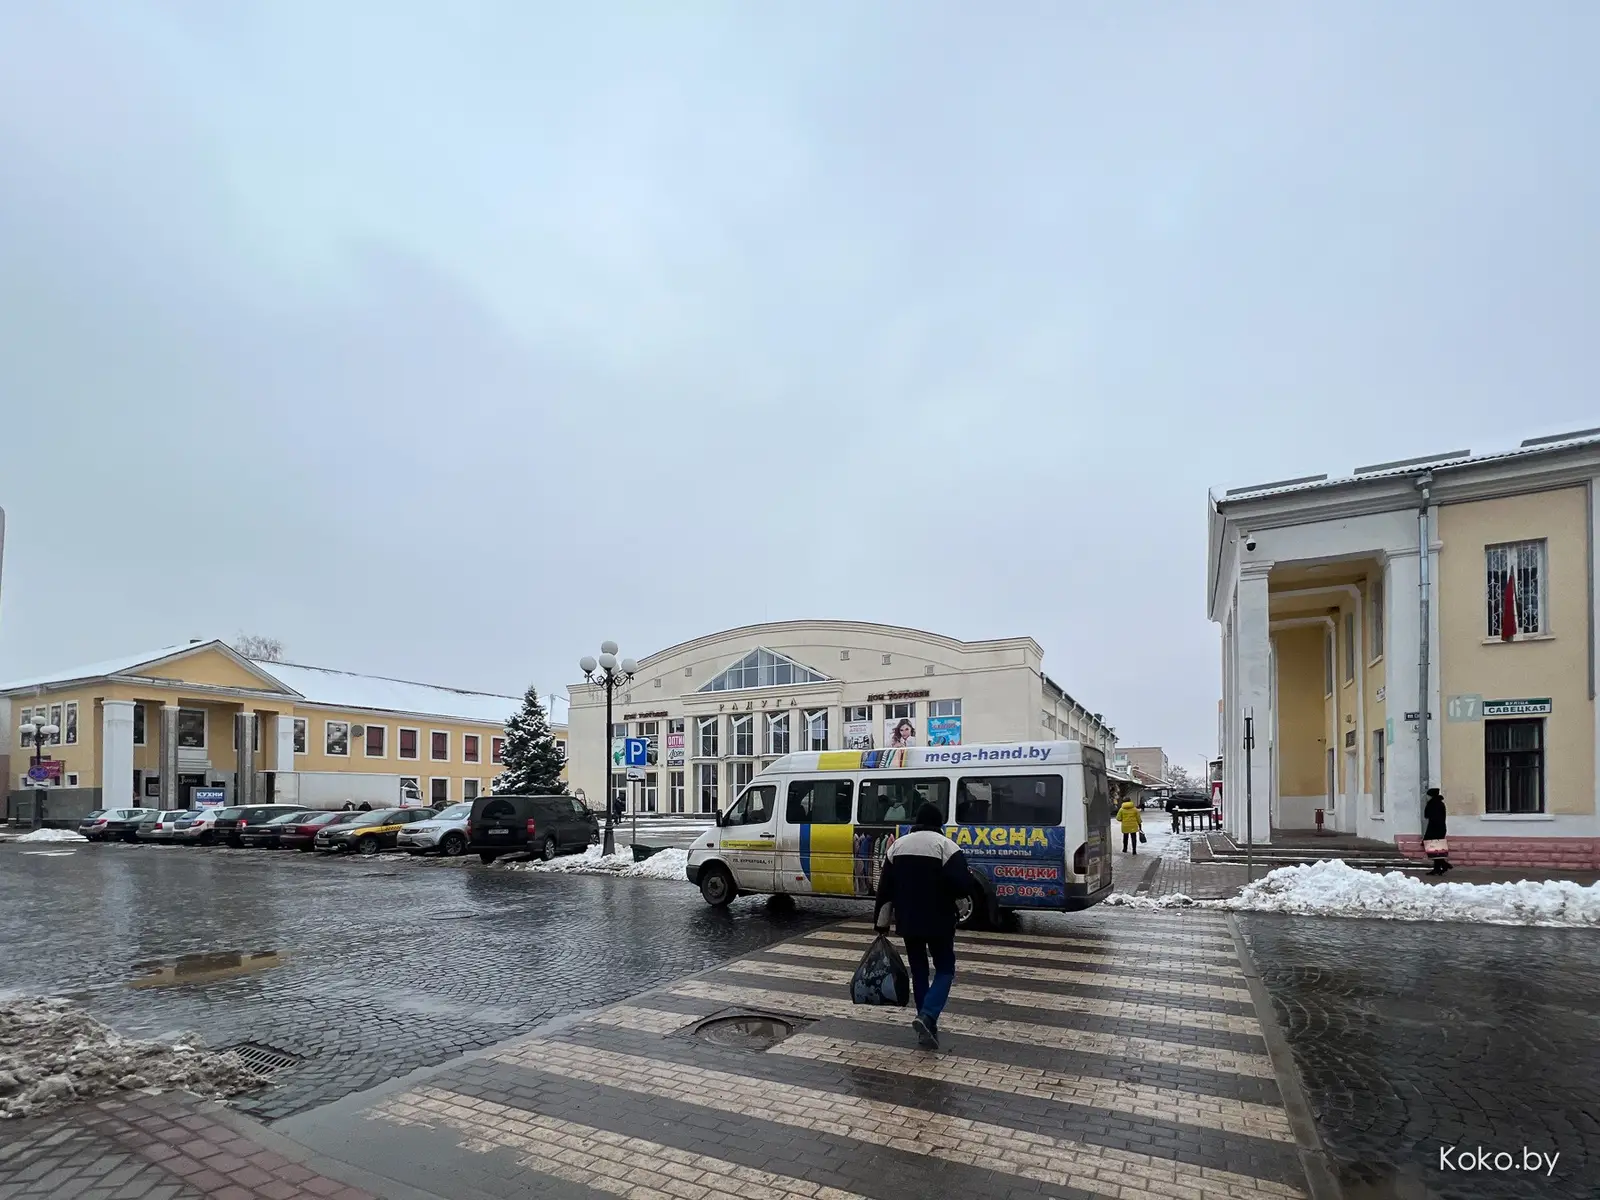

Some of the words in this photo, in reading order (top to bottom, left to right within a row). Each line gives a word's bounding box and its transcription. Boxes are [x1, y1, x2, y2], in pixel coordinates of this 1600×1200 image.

[719, 697, 798, 712] РАДУГА
[1488, 705, 1546, 714] САВЕЦКАЯ
[631, 741, 643, 763] P
[925, 746, 1052, 764] mega-hand.by
[998, 849, 1032, 857] ЕВРОПЫ
[993, 865, 1058, 881] СКИДКИ
[996, 884, 1015, 896] ДО
[1017, 885, 1045, 897] 90%
